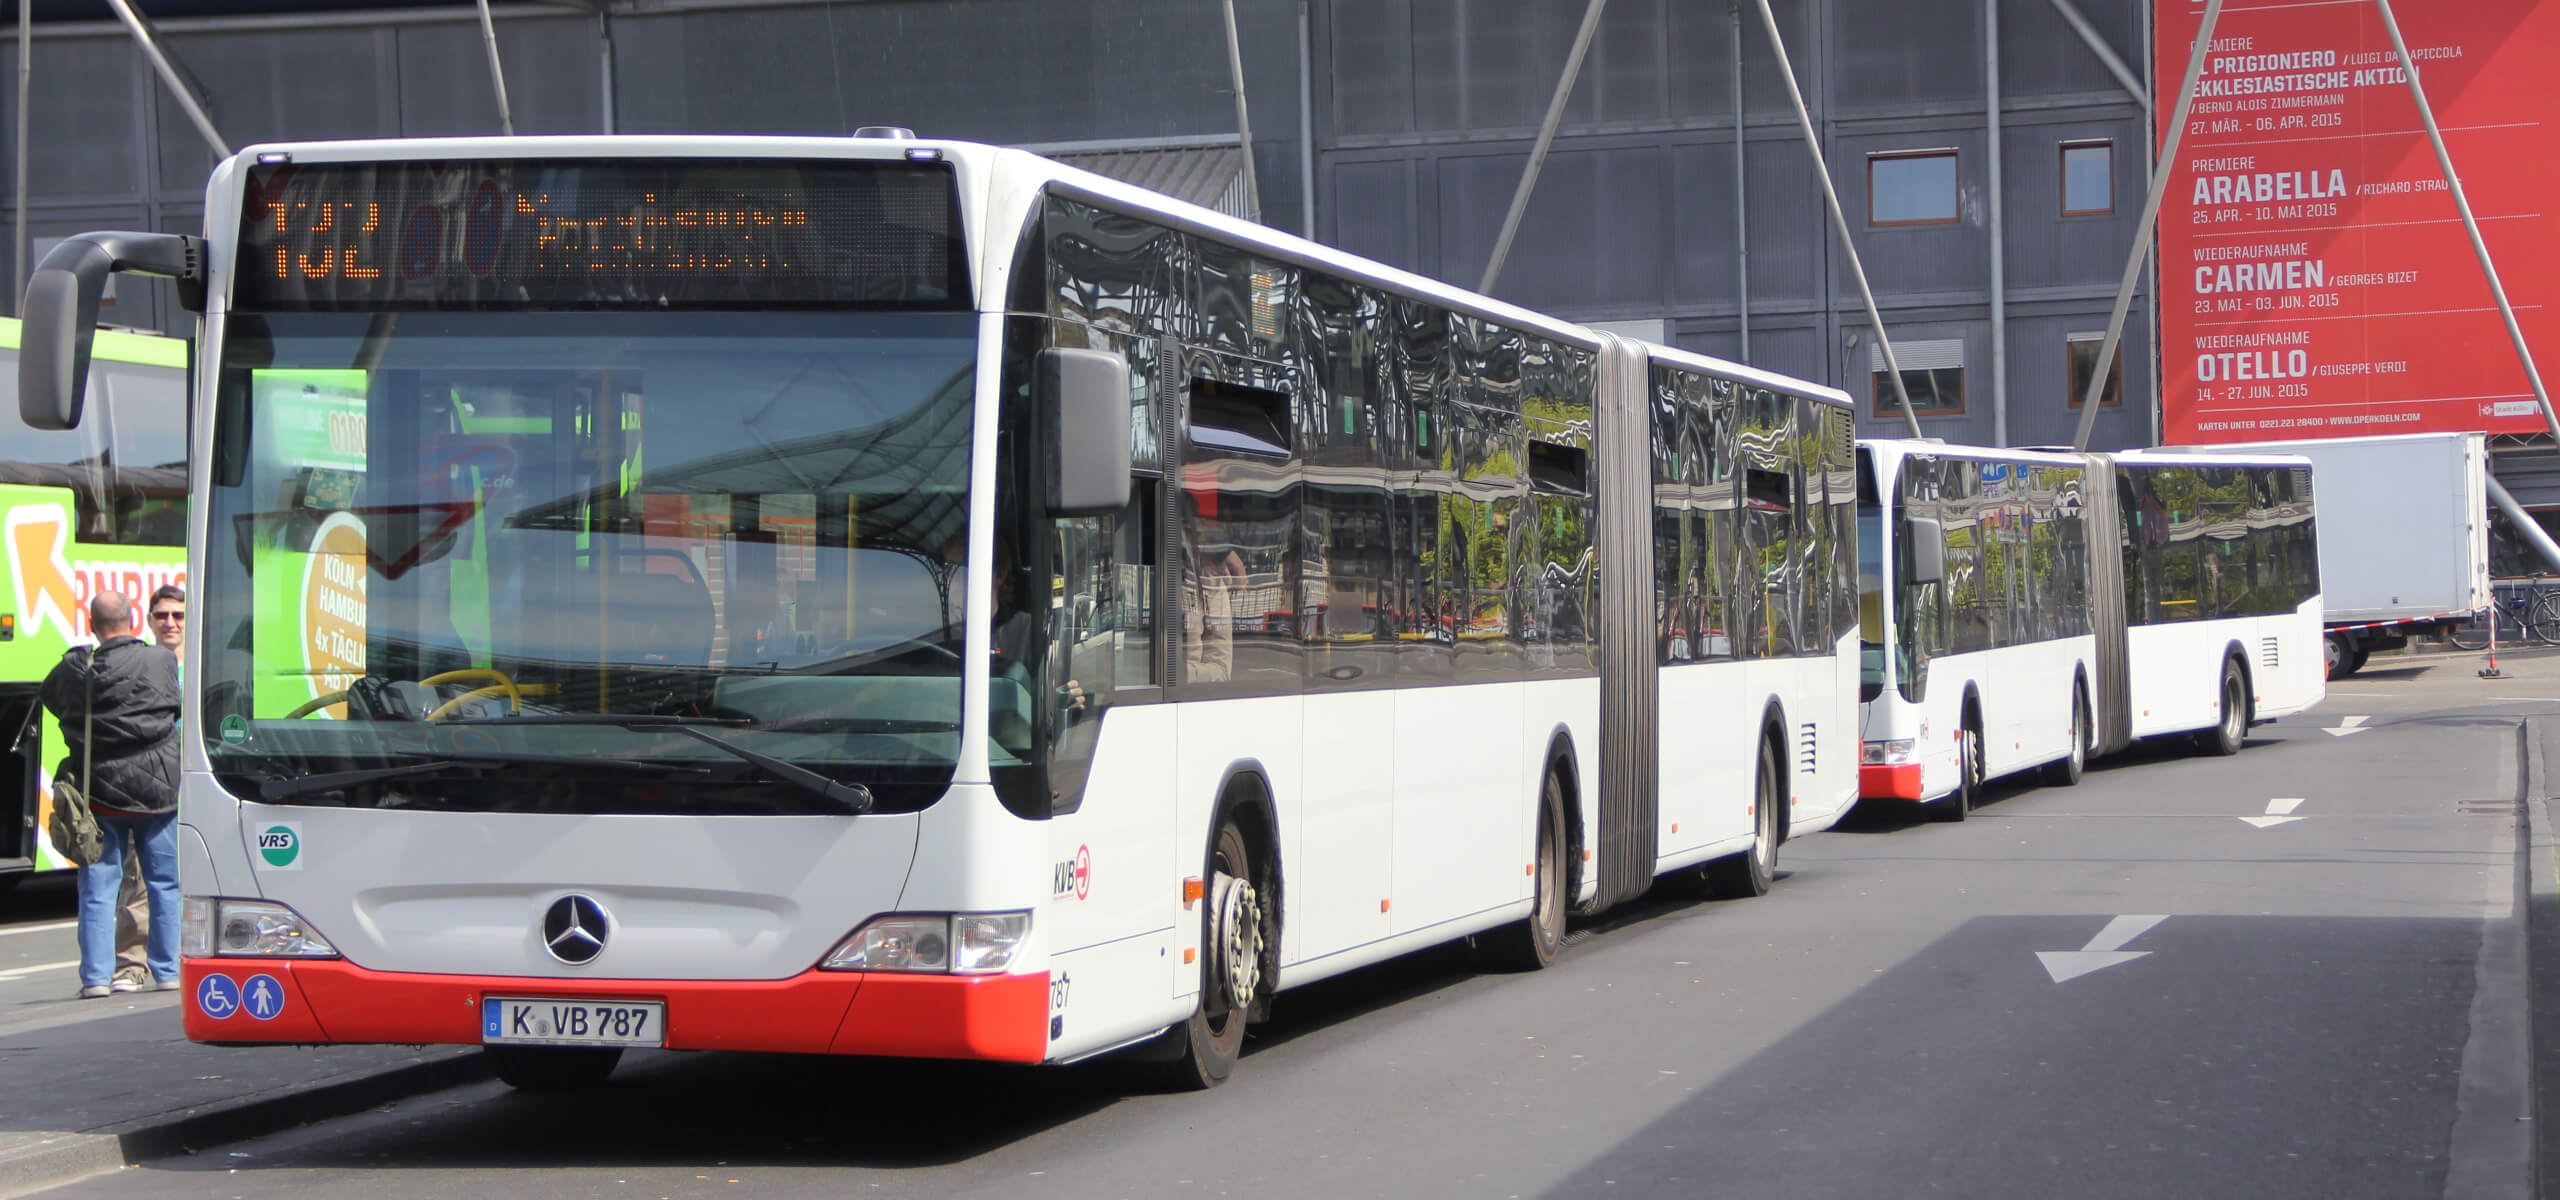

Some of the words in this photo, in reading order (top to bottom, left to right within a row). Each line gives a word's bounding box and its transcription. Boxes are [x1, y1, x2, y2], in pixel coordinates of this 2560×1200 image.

[2191, 37, 2253, 54] PEMIERE
[2214, 50, 2336, 75] PRIGIONIERO
[2351, 52, 2381, 66] LUIGI
[2385, 45, 2462, 63] DAAPICCOLA
[2192, 70, 2349, 98] EKKLESIASTISCHE
[2199, 101, 2233, 114] BERND
[2236, 98, 2267, 112] ALOIS
[2271, 94, 2344, 110] ZIMMERMANN
[2191, 122, 2208, 135] 27.
[2256, 117, 2276, 131] 06.
[2279, 115, 2307, 129] APR.
[2311, 112, 2342, 127] 2015
[2192, 156, 2255, 173] PREMIERE
[2192, 168, 2347, 206] ARABELLA
[2364, 181, 2411, 195] RICHARD
[2415, 177, 2462, 192] STRAU
[2193, 210, 2212, 224] 25.
[2215, 208, 2242, 222] APR.
[2256, 207, 2274, 221] 10.
[2278, 205, 2303, 219] MAI
[2306, 202, 2337, 217] 2015
[2193, 242, 2308, 262] WIEDERAUFNAHME
[2195, 259, 2324, 294] CARMEN
[2336, 272, 2384, 287] GEORGES
[2387, 270, 2418, 283] BIZET
[2195, 299, 2214, 313] 23.
[2218, 298, 2242, 312] MAI
[2256, 296, 2275, 310] 03.
[2279, 295, 2304, 310] JUN.
[2309, 293, 2339, 308] 2015
[2196, 330, 2310, 349] WIEDERAUFNAHME
[2197, 349, 2307, 382] OTELLO
[2320, 363, 2371, 377] GIUSEPPE
[2374, 361, 2407, 374] VERDI
[2197, 387, 2215, 401] 14.
[2227, 386, 2245, 400] 27.
[2249, 385, 2274, 399] JUN.
[2278, 383, 2308, 398] 2015
[2198, 422, 2228, 431] KARTEN
[2230, 420, 2256, 430] UNTER
[2330, 413, 2421, 425] WWW.OPERKOELN.COM
[324, 553, 355, 590] KÖLN
[258, 834, 289, 848] VRS
[1054, 860, 1075, 895] KVB
[513, 1005, 532, 1035] K
[552, 1006, 590, 1036] VB
[595, 1007, 649, 1037] 787
